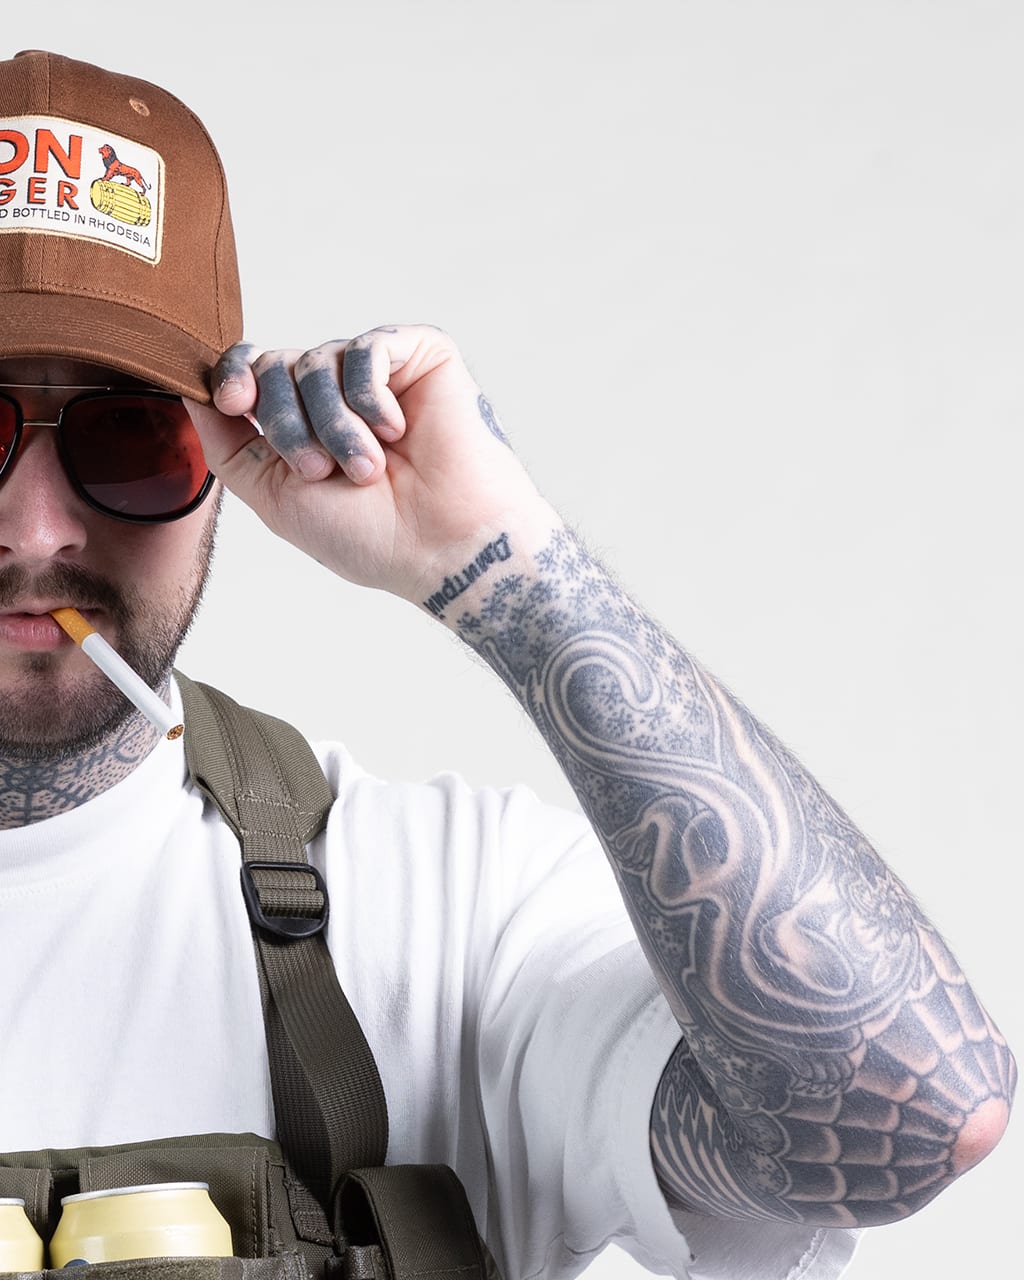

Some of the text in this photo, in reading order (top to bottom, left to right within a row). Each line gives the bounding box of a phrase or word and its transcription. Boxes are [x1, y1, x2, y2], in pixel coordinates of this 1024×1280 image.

[12, 207, 71, 223] BOTTLED
[73, 213, 87, 226] IN
[88, 217, 152, 248] RHODESIA
